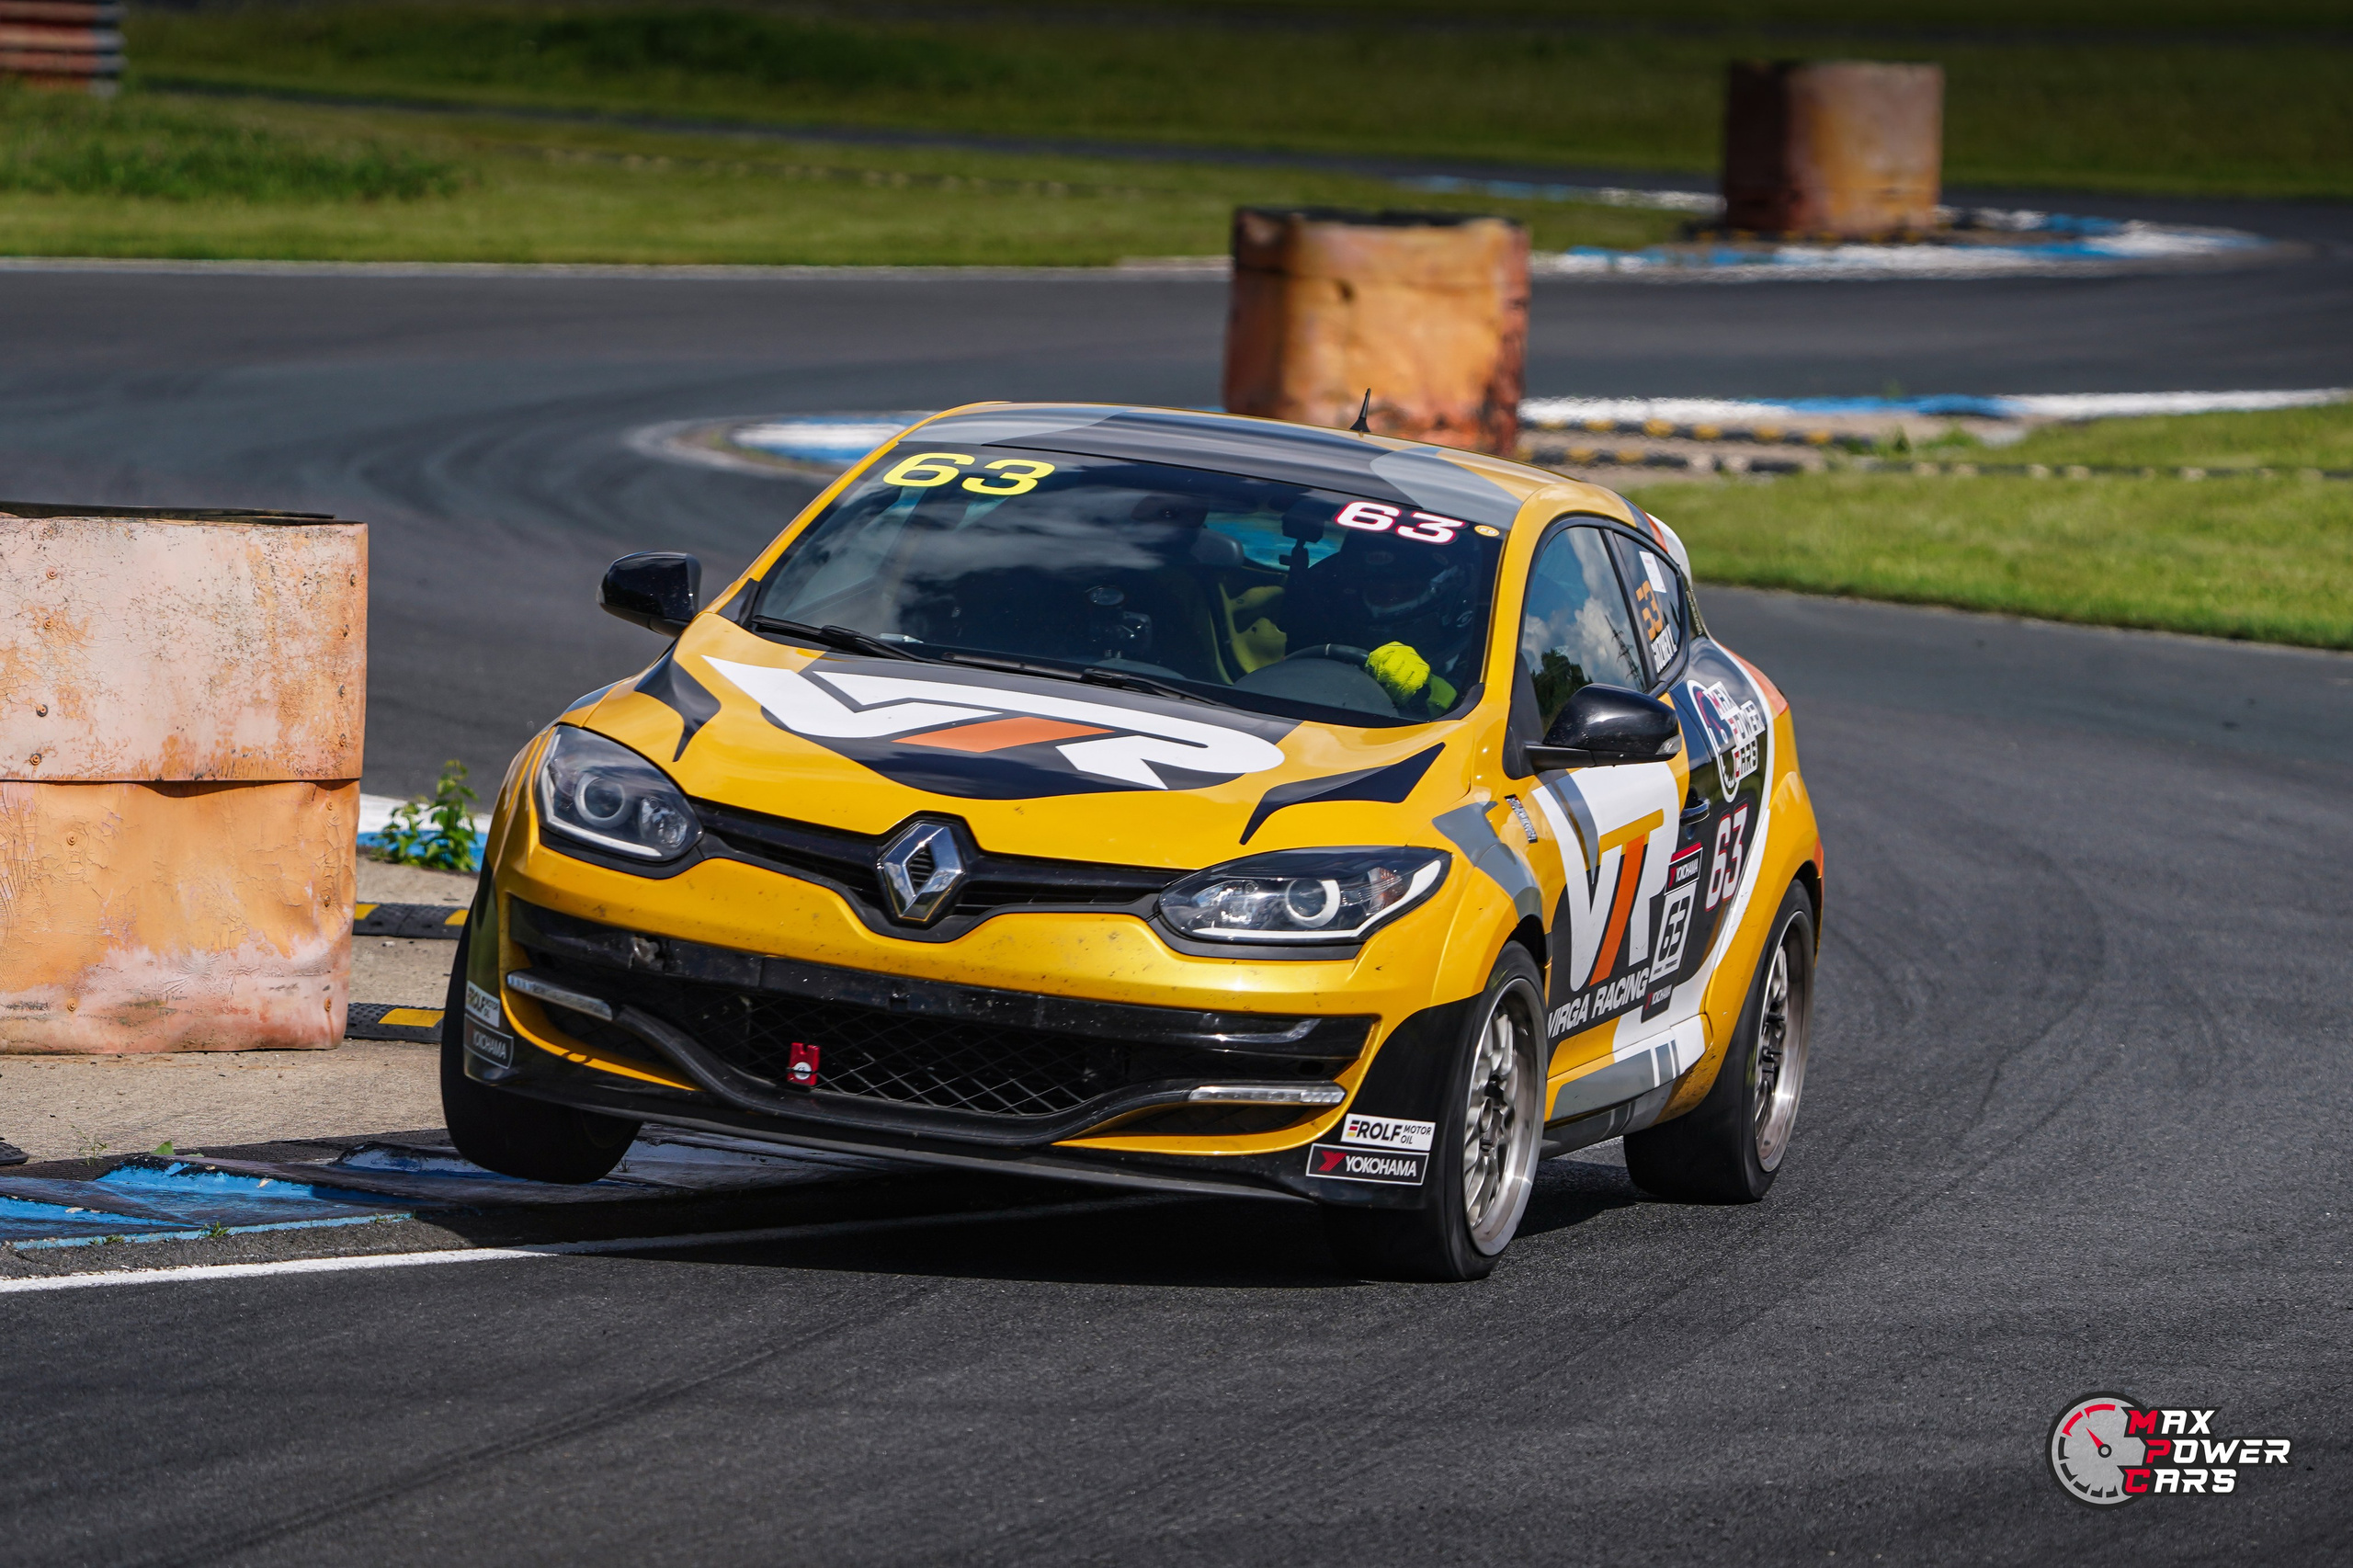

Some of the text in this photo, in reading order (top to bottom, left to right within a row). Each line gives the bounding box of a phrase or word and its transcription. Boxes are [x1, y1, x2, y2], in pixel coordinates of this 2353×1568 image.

[882, 452, 1056, 496] 63
[1335, 500, 1468, 546] 63
[1675, 858, 1699, 883] YOKOHAMA
[1705, 803, 1748, 912] 63
[1658, 895, 1691, 962] 63
[1548, 967, 1649, 1039] VIRGA RACING
[1357, 1121, 1431, 1142] ROLF MOTOR
[1401, 1136, 1413, 1144] OIL
[1346, 1155, 1417, 1177] YOKOHAMA
